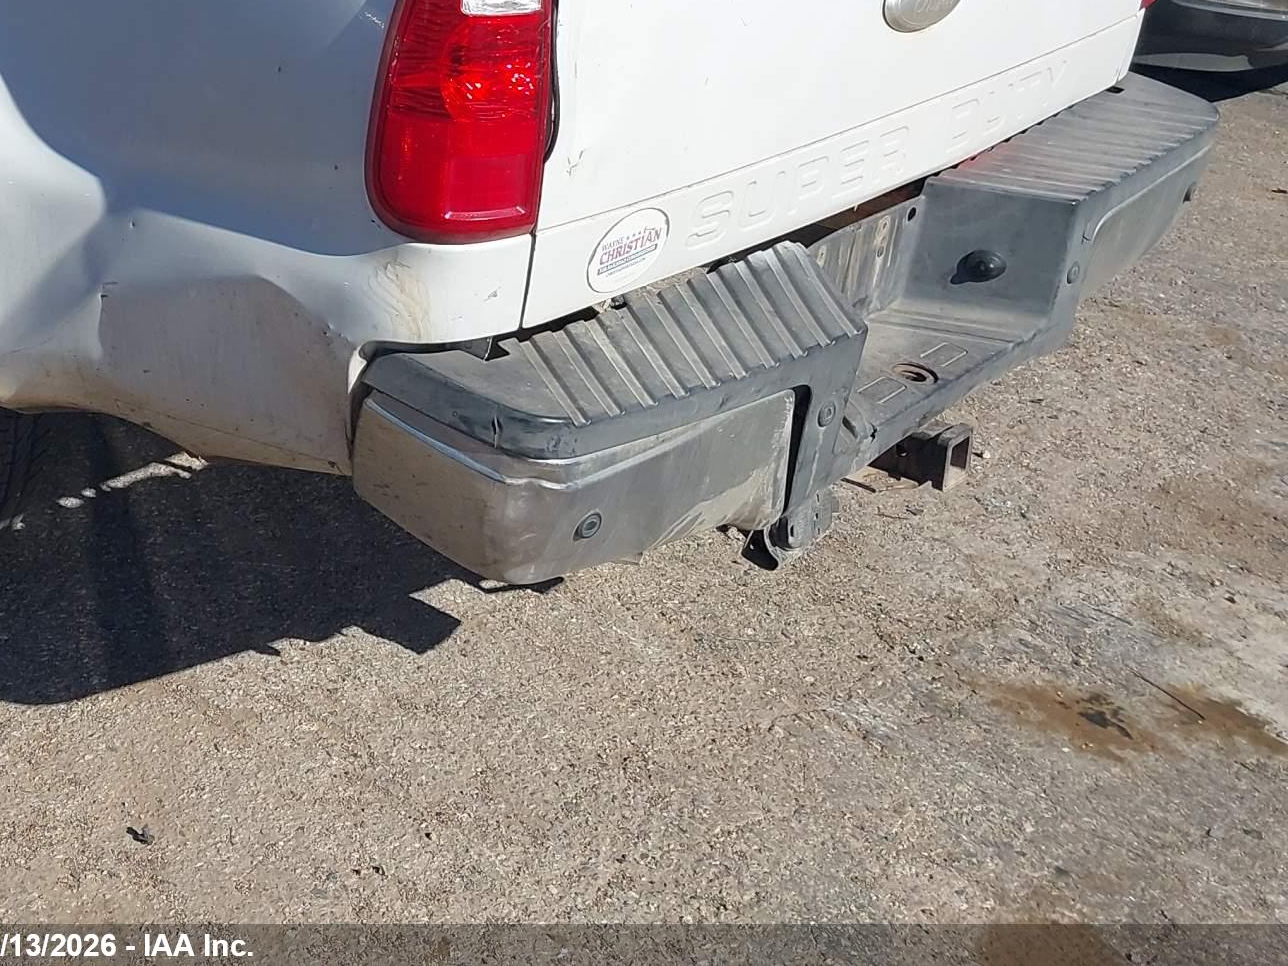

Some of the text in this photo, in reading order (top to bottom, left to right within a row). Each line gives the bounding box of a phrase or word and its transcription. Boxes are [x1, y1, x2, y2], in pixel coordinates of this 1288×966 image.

[944, 58, 1069, 156] DUTY
[685, 124, 911, 251] SUPER
[599, 227, 662, 265] CHRISTIAN
[601, 236, 624, 251] WAYNE
